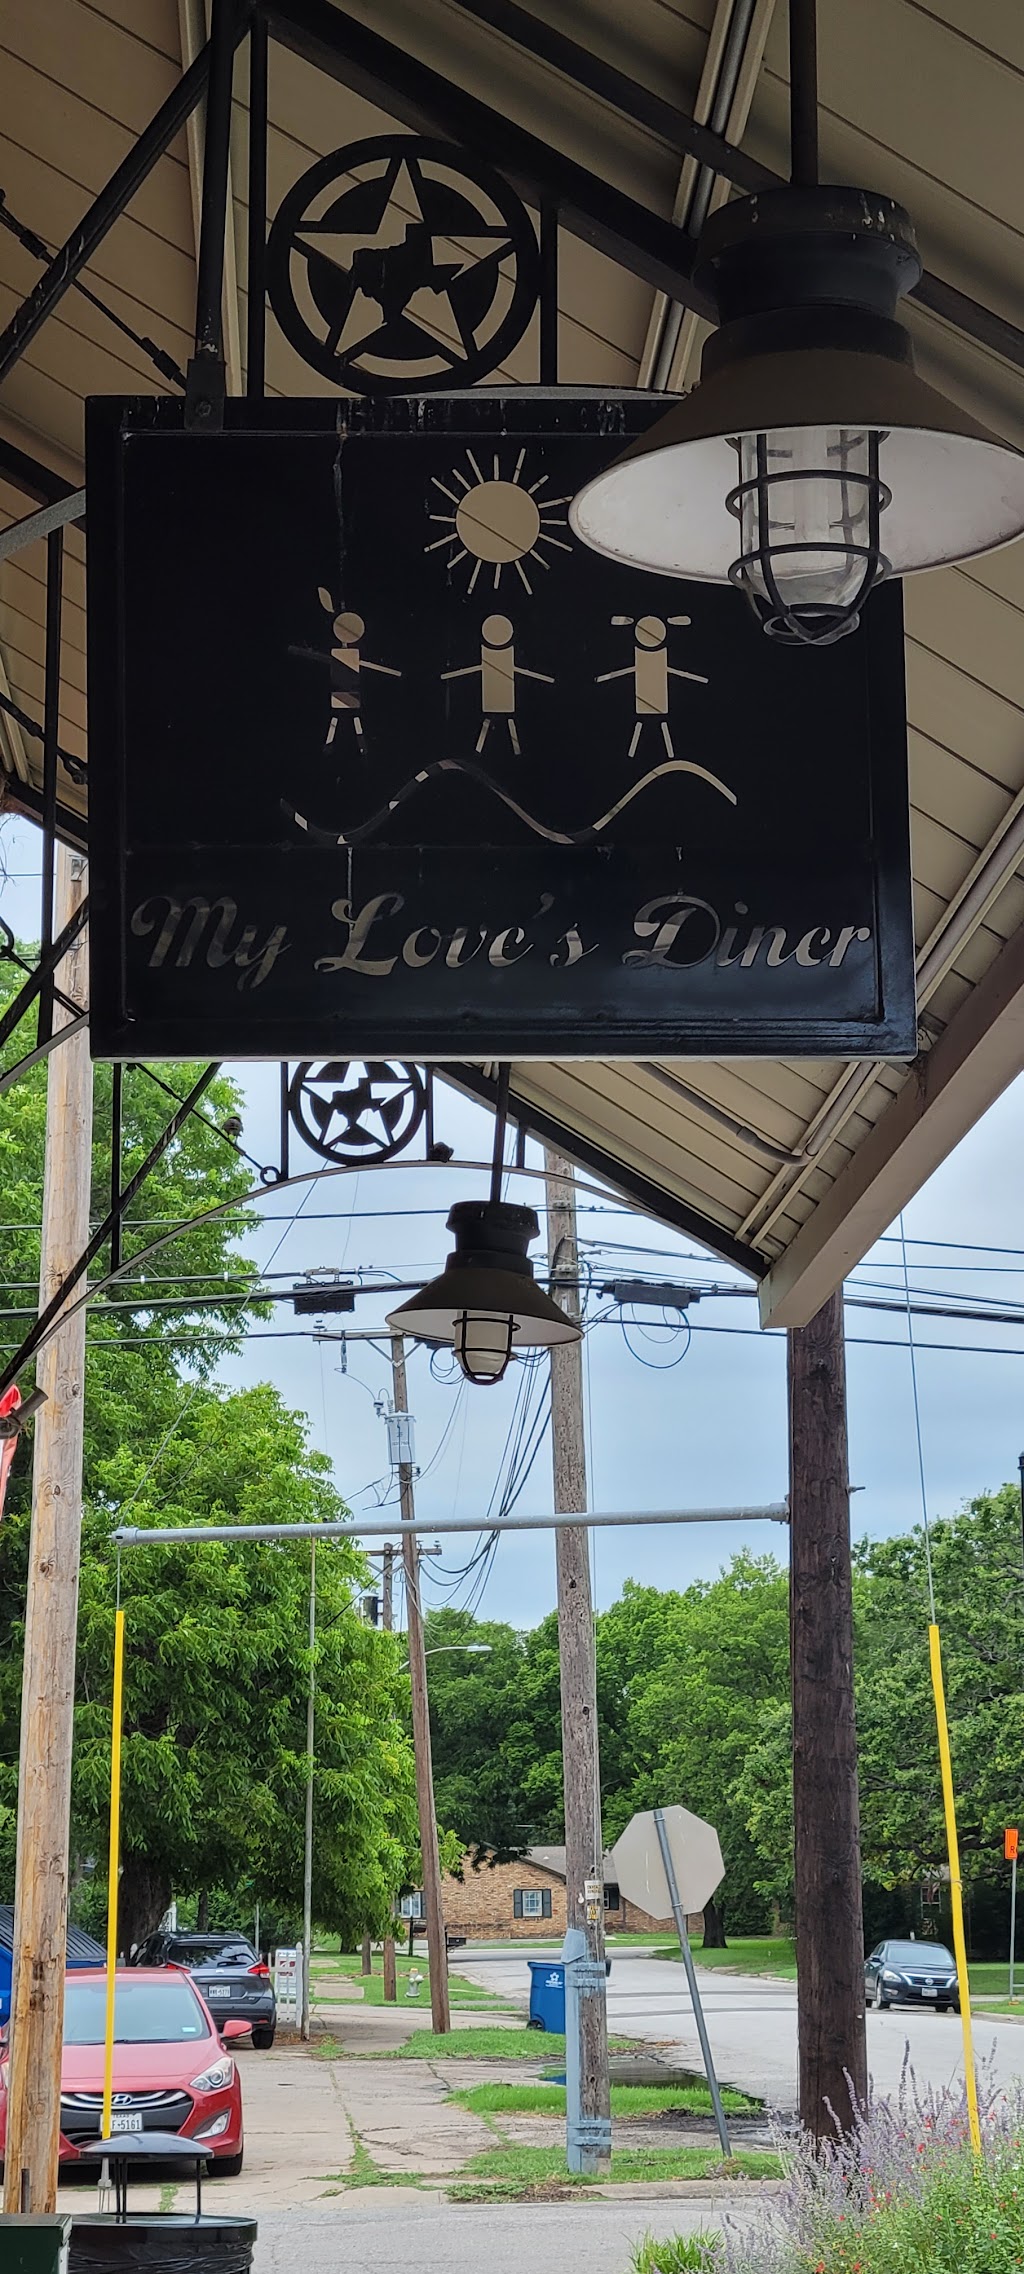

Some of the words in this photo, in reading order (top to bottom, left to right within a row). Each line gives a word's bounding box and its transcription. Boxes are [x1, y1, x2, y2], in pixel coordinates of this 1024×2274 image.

[131, 896, 293, 991] My
[314, 892, 599, 976] Love's
[621, 893, 870, 969] Diner
